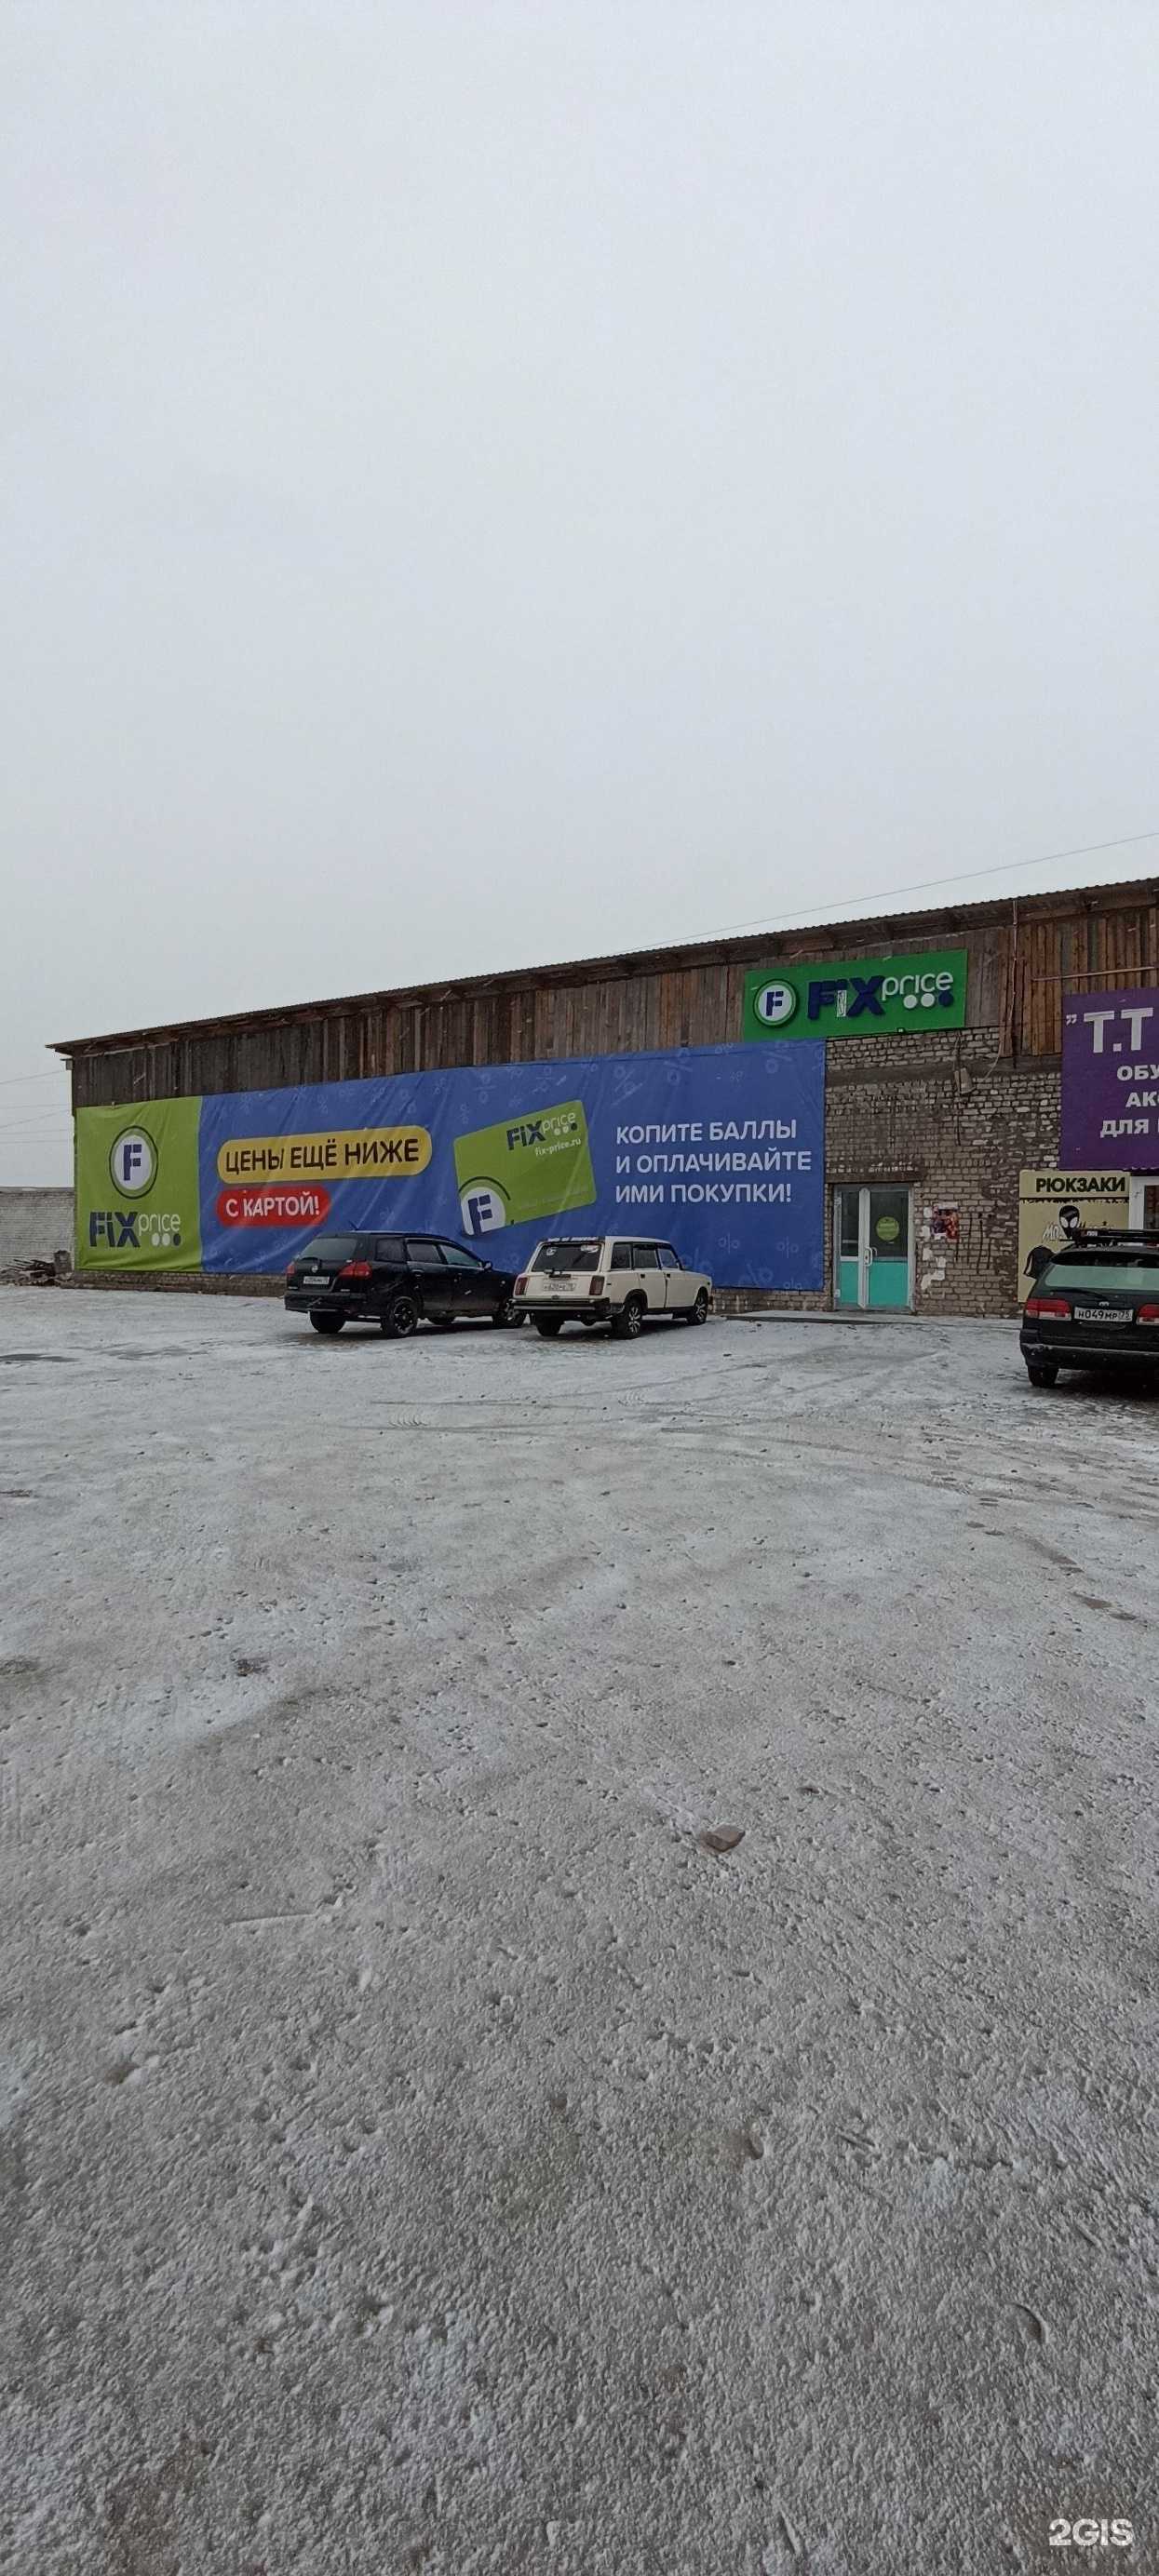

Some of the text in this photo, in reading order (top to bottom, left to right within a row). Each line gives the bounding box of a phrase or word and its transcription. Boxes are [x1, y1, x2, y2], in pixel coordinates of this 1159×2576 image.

[766, 991, 784, 1016] F
[1125, 1092, 1159, 1107] АК
[616, 1120, 797, 1144] КОПИТЕ БАЛЛЫ
[1099, 1119, 1150, 1138] ДЛЯ
[226, 1138, 419, 1175] ЦЕНЫ ЕЩЁ НИЖЕ
[534, 1138, 582, 1157] fix-price.ru
[123, 1144, 142, 1181] F
[616, 1147, 812, 1174] И ОПЛАЧИВАЙТЕ
[615, 1183, 791, 1203] ИМИ ПОКУПКИ!
[1035, 1177, 1125, 1192] РЮКЗАКИ
[225, 1191, 319, 1217] С КАРТОЙ!
[139, 1214, 182, 1236] price
